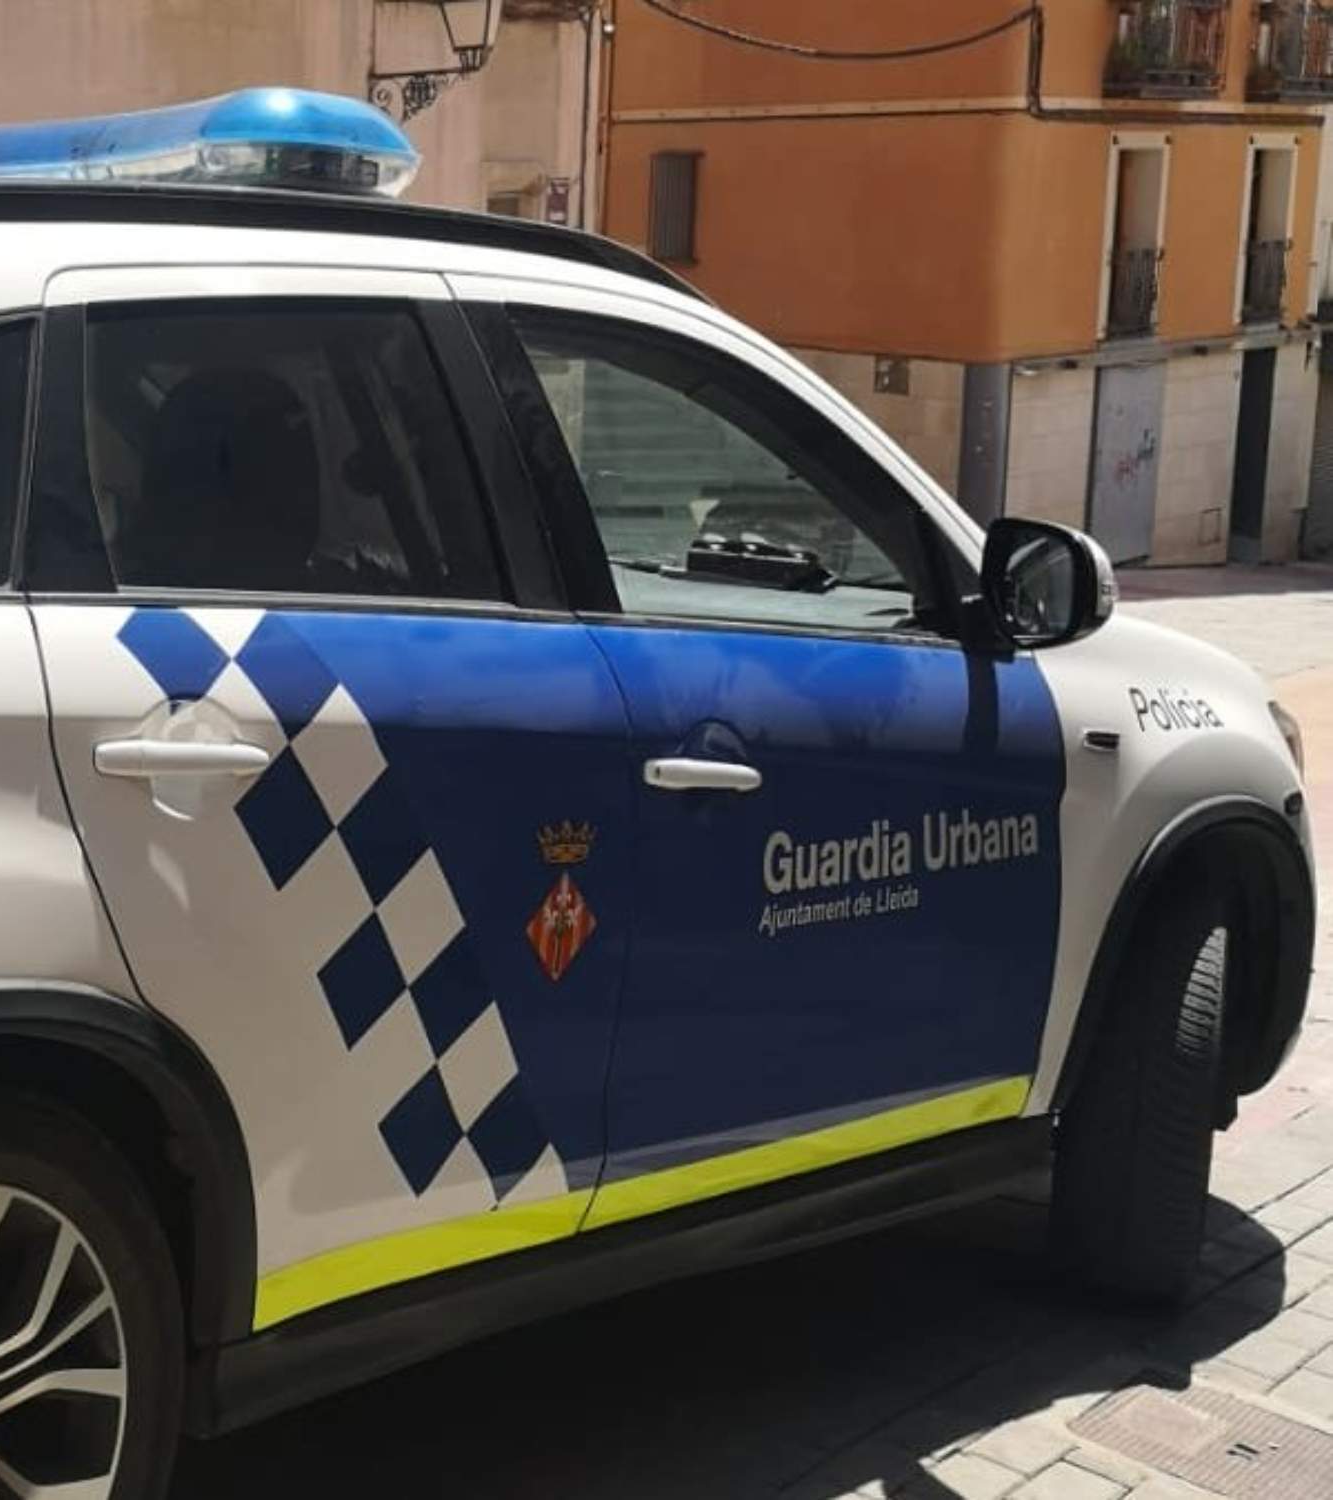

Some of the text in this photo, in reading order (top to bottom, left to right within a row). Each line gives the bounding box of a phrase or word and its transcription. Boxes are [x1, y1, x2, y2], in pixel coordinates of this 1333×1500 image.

[763, 807, 1038, 895] Guardia Urbana
[758, 882, 920, 937] Ajuntament de Lleida
